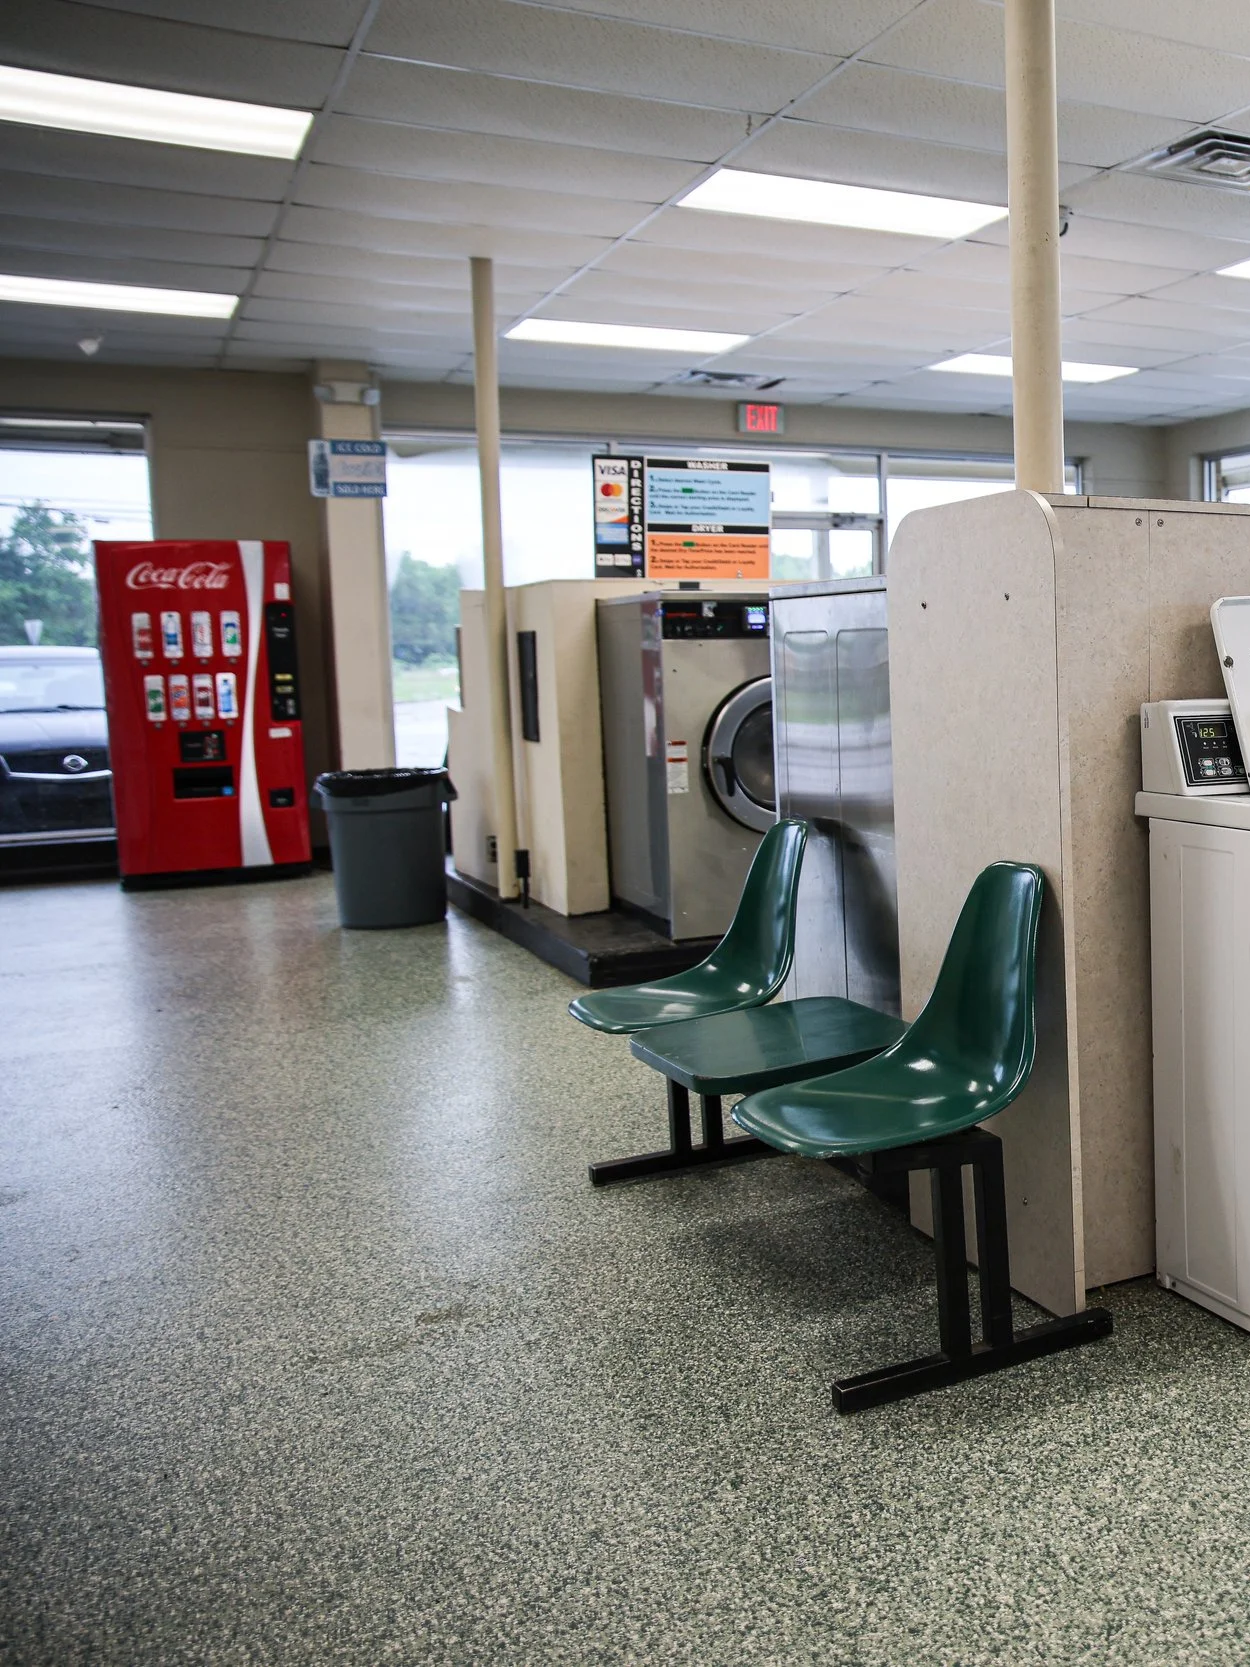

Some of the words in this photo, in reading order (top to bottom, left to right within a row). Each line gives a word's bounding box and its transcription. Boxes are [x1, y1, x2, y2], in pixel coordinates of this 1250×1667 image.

[746, 404, 778, 432] EXIT
[599, 465, 627, 475] VISA
[630, 460, 643, 551] DIRECTIONS
[691, 523, 725, 532] DRYER
